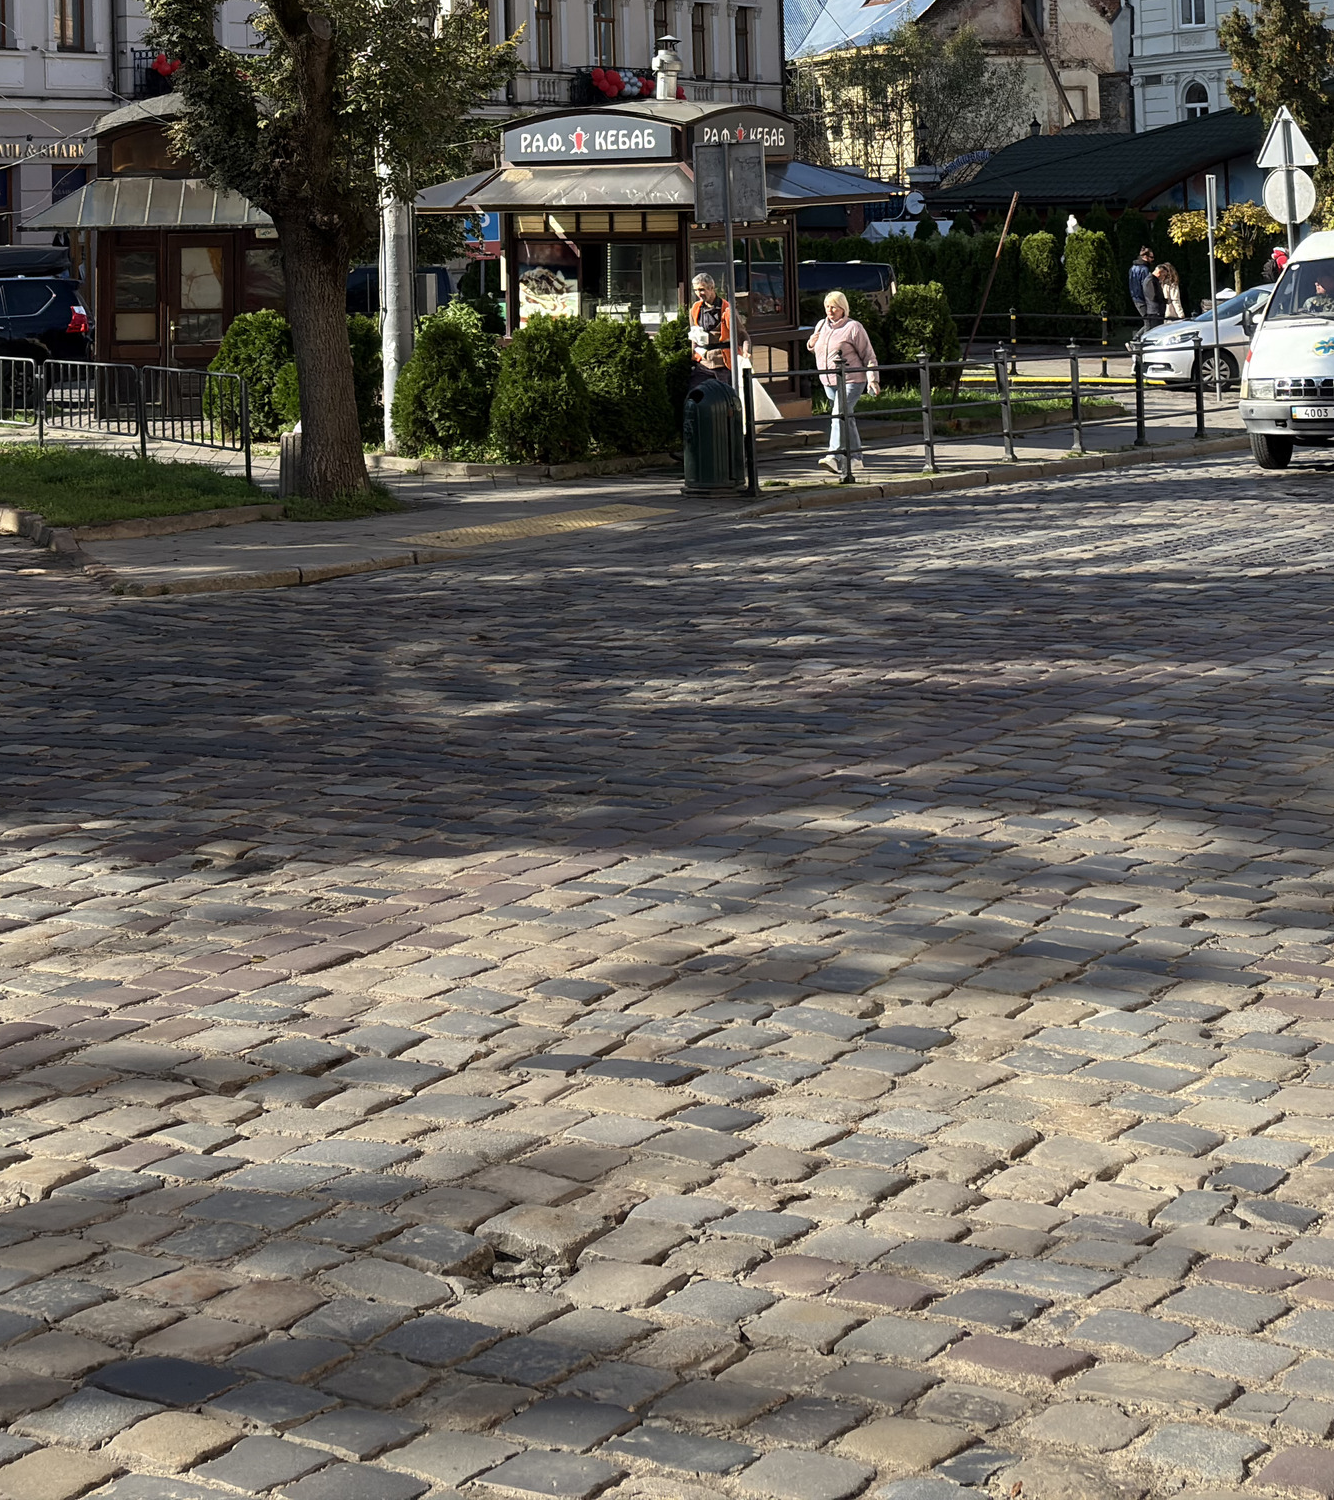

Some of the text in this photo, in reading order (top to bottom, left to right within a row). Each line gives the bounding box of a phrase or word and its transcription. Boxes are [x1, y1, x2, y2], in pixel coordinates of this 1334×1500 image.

[520, 128, 656, 153] Р.А.Ф. КЕБАБ
[25, 143, 37, 158] &
[39, 143, 86, 158] SHARK
[1304, 408, 1329, 418] 4003
